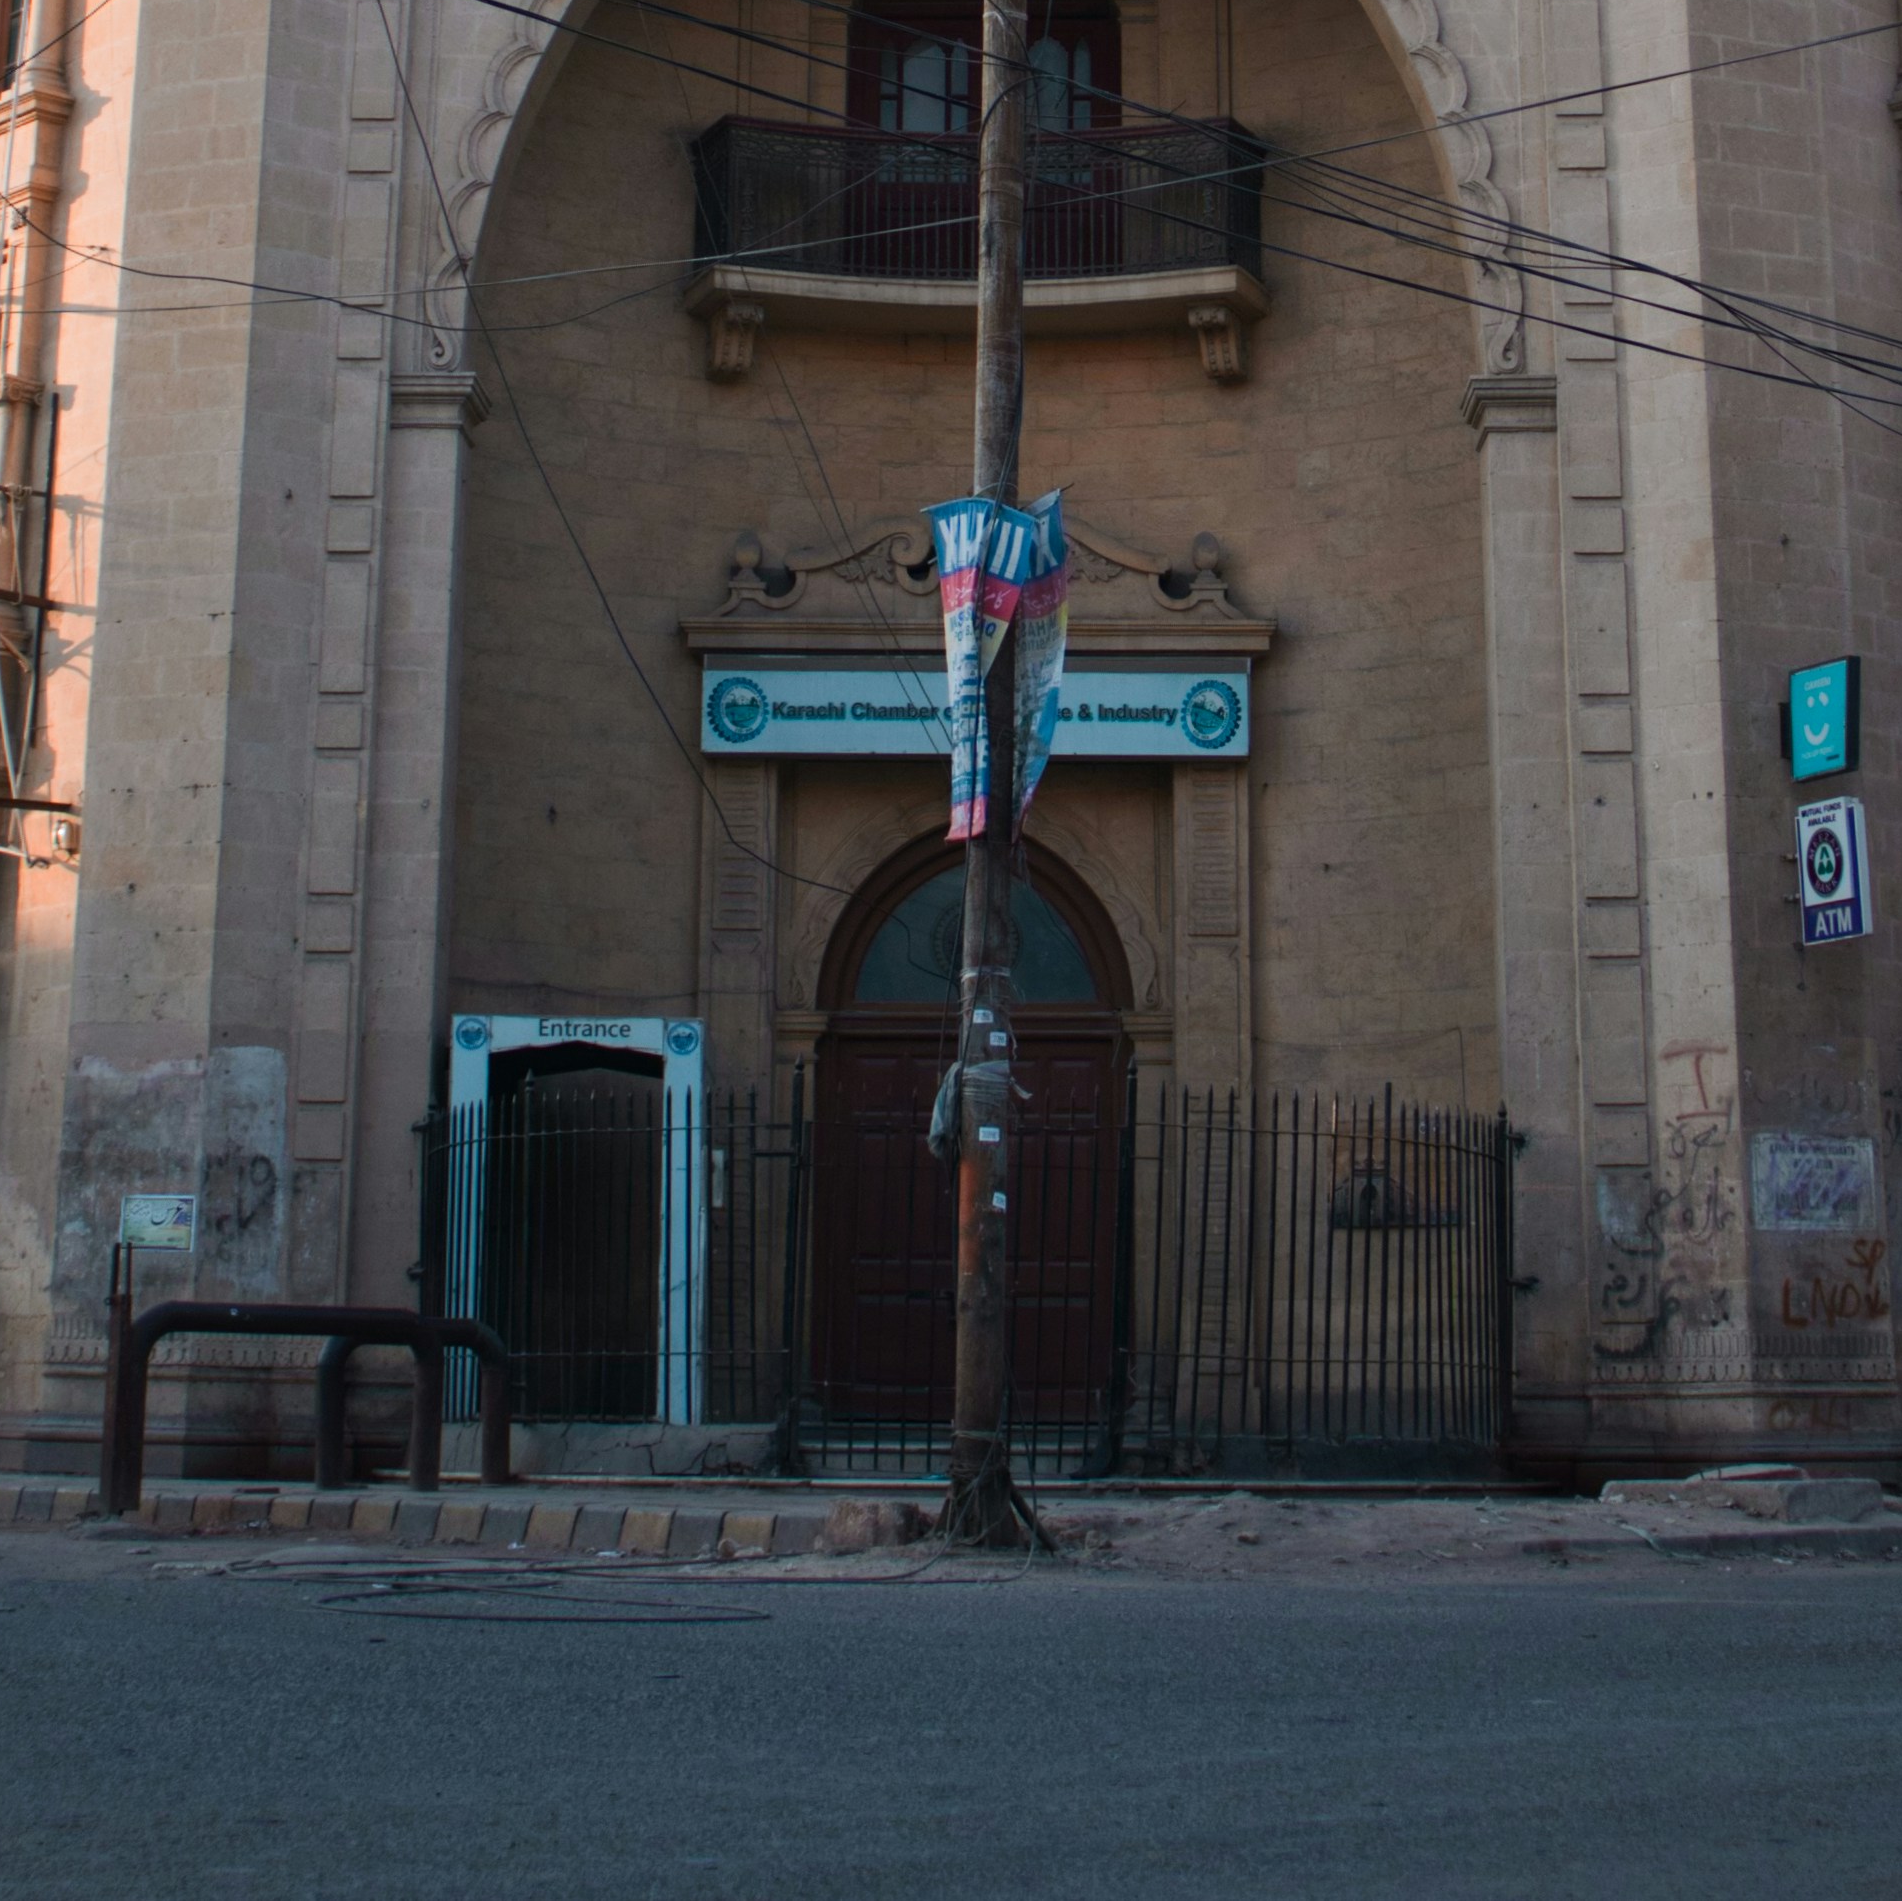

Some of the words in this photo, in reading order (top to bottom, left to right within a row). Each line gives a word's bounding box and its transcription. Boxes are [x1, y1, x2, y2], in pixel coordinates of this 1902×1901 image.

[772, 702, 846, 720] Karachi
[851, 702, 940, 720] Chamber
[1077, 703, 1094, 722] &
[1098, 703, 1178, 726] Industry
[1801, 806, 1823, 818] MUTUAL
[1824, 802, 1841, 812] FUNDS
[1808, 814, 1836, 827] AVAILABLE
[1814, 906, 1853, 938] ATM
[538, 1018, 631, 1037] Entrance
